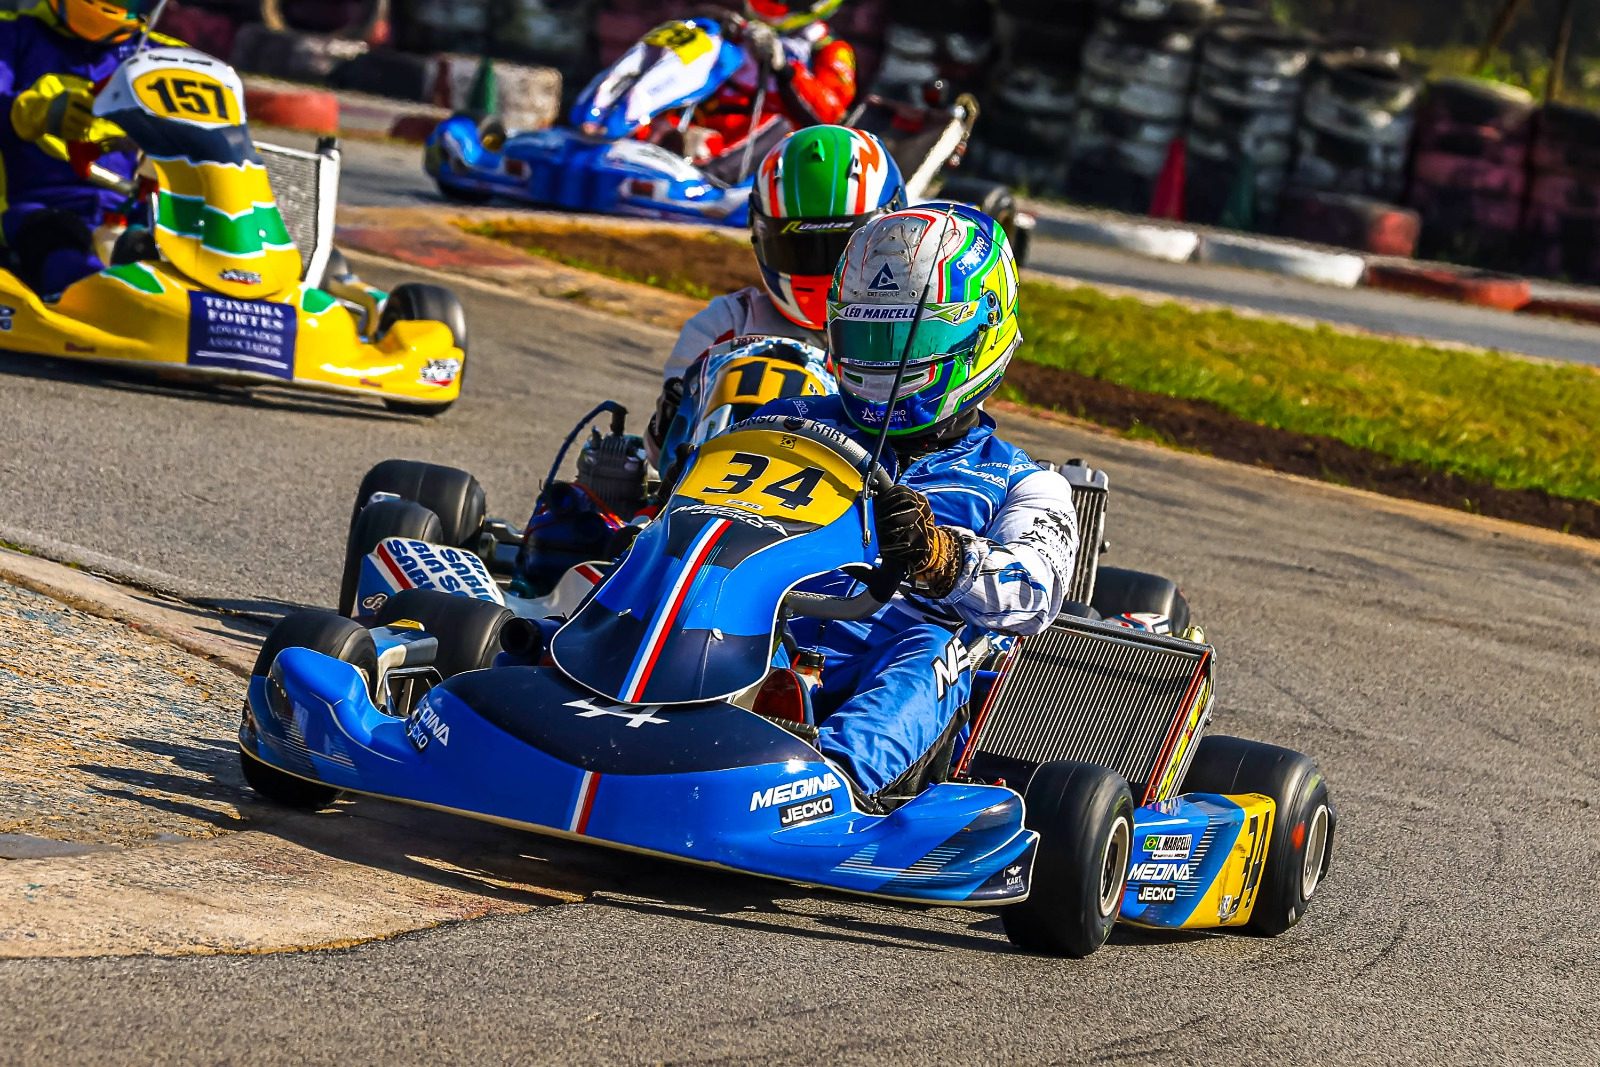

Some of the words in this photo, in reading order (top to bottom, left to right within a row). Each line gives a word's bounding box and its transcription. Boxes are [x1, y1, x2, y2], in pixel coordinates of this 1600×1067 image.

[147, 78, 229, 119] 157
[203, 296, 284, 318] TEIXEIRA
[207, 308, 284, 331] FORTES
[863, 307, 917, 318] MARCELL
[729, 360, 808, 396] 11
[701, 452, 826, 510] 34
[670, 504, 788, 537] MEDINA
[690, 509, 764, 529] JECKO
[749, 772, 841, 812] MEDINA
[781, 797, 833, 825] JECKO
[1127, 864, 1190, 880] MEDINA
[1138, 887, 1176, 901] JECKO
